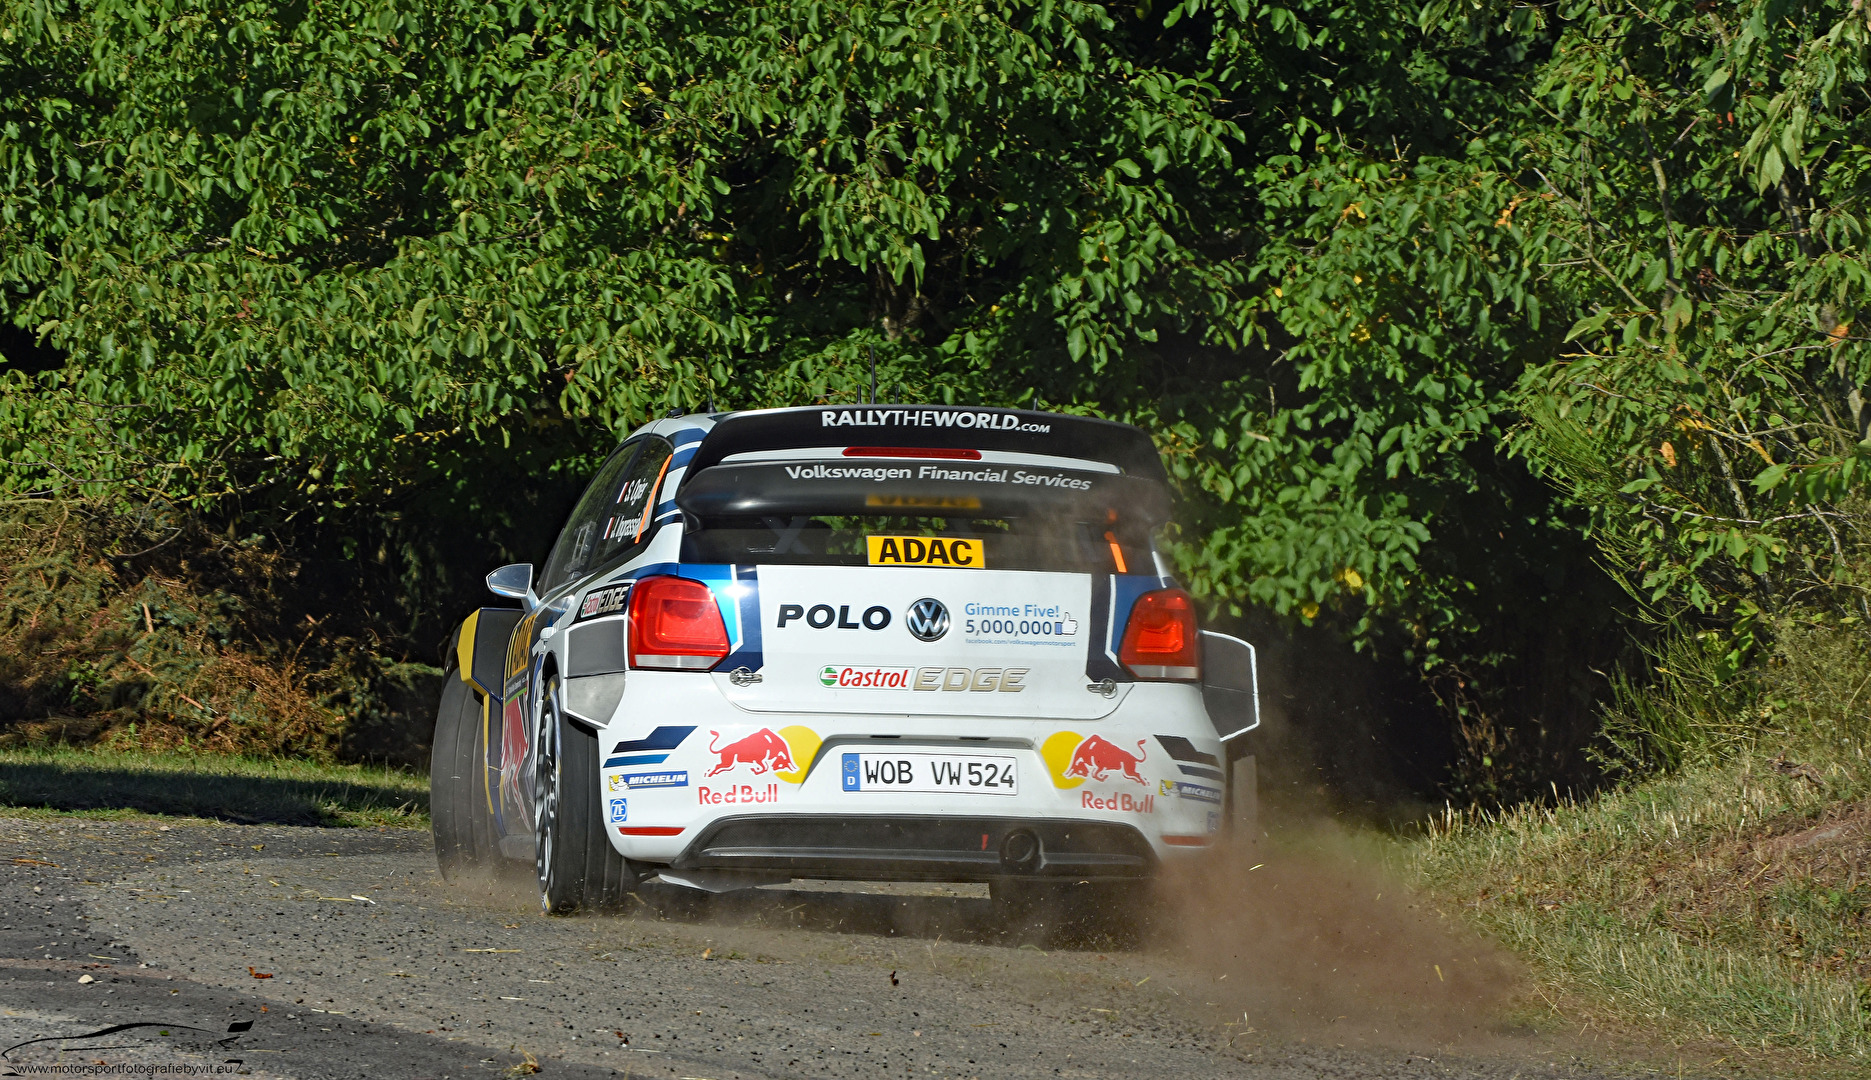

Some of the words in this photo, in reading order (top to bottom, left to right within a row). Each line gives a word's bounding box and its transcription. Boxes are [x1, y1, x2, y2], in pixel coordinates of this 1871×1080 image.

[785, 465, 911, 482] Volkswagen
[919, 466, 1006, 483] Financial
[1012, 470, 1092, 490] Services
[879, 538, 973, 565] ADAC
[777, 604, 891, 630] POLO
[965, 602, 1020, 617] Gimme
[1024, 604, 1060, 618] Five!
[965, 619, 1052, 637] 5,000,000
[839, 667, 909, 688] Castrol
[912, 667, 1031, 693] EDGE
[628, 774, 687, 785] MICHELIN
[847, 776, 856, 786] D
[864, 760, 913, 785] WOB
[699, 785, 737, 804] Red
[741, 784, 778, 803] Bull
[1082, 790, 1118, 810] Red
[1121, 793, 1154, 813] Bull
